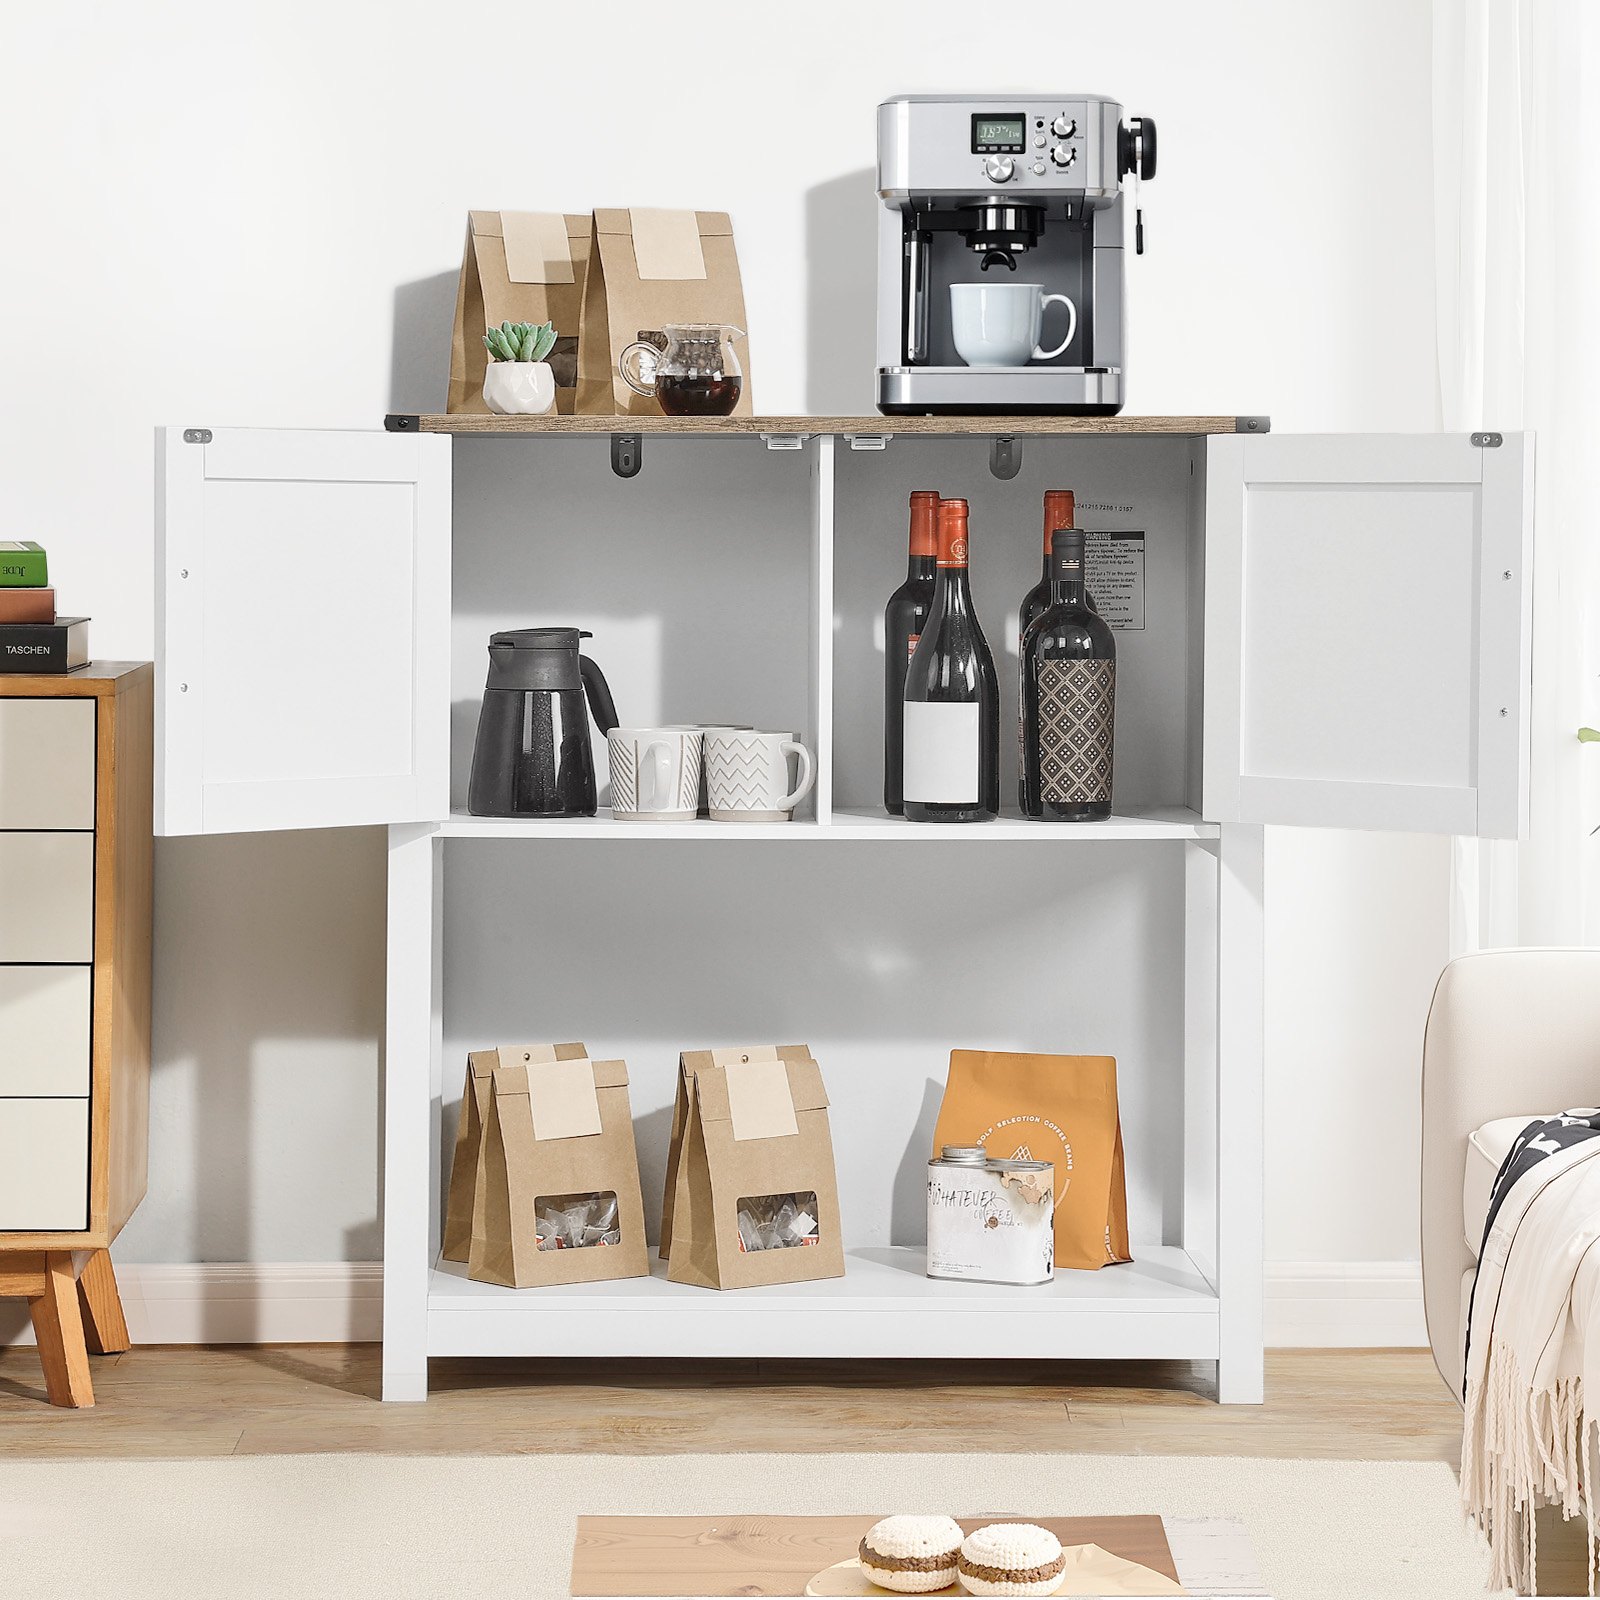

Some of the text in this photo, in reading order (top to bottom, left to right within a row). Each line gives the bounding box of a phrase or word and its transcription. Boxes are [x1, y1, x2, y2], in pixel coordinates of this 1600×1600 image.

[5, 645, 51, 655] TASCHEN
[997, 1115, 1041, 1128] SELECTION
[1043, 1119, 1067, 1142] COFFEE
[1064, 1143, 1073, 1171] BEANS
